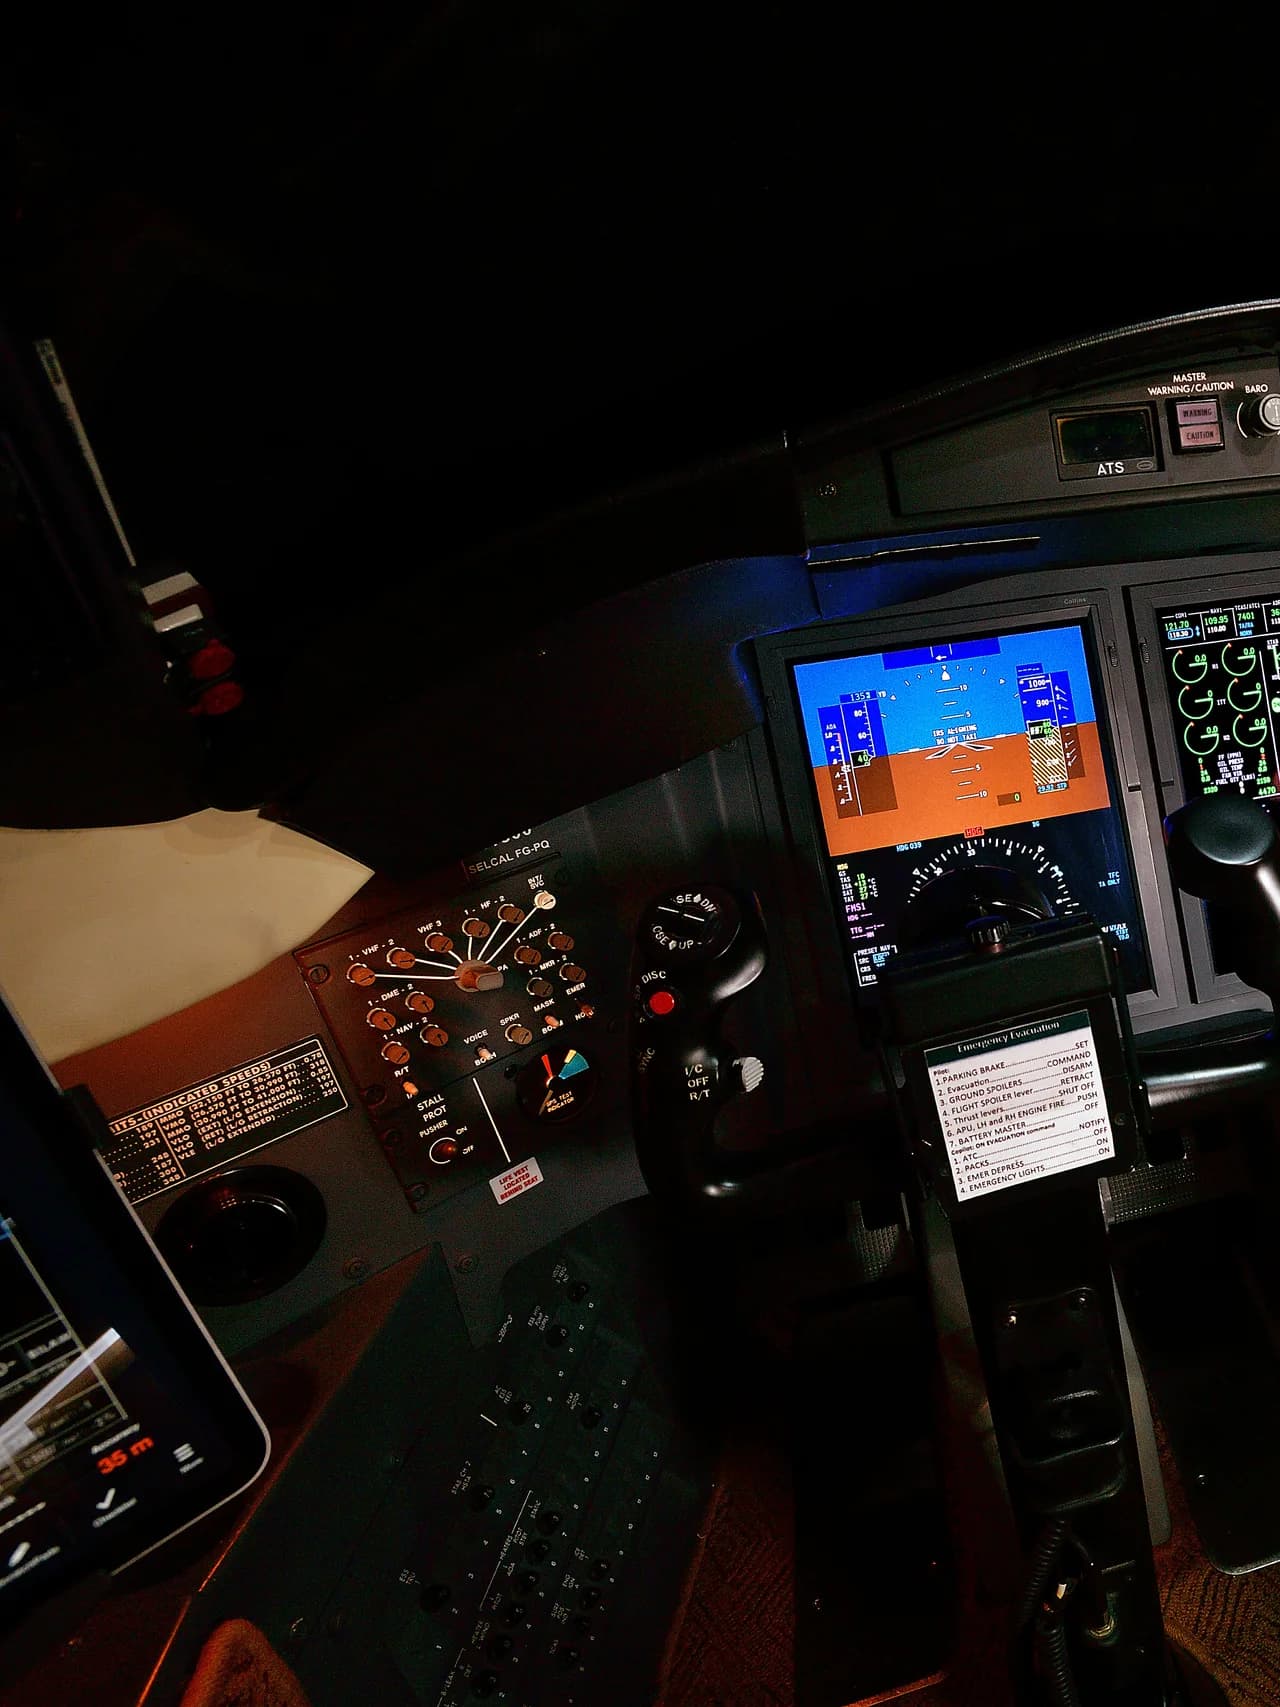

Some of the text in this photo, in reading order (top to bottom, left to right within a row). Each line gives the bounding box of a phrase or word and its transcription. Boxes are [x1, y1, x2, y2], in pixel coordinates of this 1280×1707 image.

[1172, 371, 1207, 383] MASTER
[1147, 381, 1234, 397] WARNING/CAUTION
[1244, 383, 1269, 394] BARO
[1182, 406, 1213, 420] WARNING
[1185, 429, 1215, 442] CAUTION
[1096, 461, 1125, 475] ATS
[1204, 615, 1229, 626] 109.95
[1237, 612, 1255, 621] 7401
[1164, 620, 1190, 632] 121.70
[959, 684, 968, 692] 10
[1258, 786, 1277, 795] 4470
[468, 839, 550, 875] SELCAL FG-PQ
[845, 902, 866, 913] FMS1
[417, 924, 435, 934] VHF
[642, 970, 667, 985] DISC
[381, 990, 400, 1002] DME
[566, 983, 586, 996] EMER
[533, 999, 555, 1012] MASK
[499, 1013, 520, 1026] SPKR
[463, 1029, 489, 1045] VOICE
[957, 1021, 1060, 1054] Emergency Evacuation
[980, 1061, 1005, 1075] BRAKE
[1075, 1040, 1089, 1050] SET
[222, 1061, 271, 1088] SPEEDS)
[394, 1066, 410, 1078] R/T
[685, 1063, 703, 1076] I/C
[947, 1050, 1091, 1095] Evacuation COMMAND
[687, 1076, 709, 1088] OFF
[949, 1061, 1093, 1105] GROUND SPOILERS DISARM
[163, 1059, 326, 1131] VMO 318
[689, 1088, 711, 1101] R/T
[951, 1071, 1094, 1116] FLIGHT SPOILER lever RETRACT
[159, 1083, 250, 1124] MMO TO
[417, 1094, 445, 1112] STALL
[954, 1081, 1095, 1126] Thrust levers SHUT OFF
[976, 1091, 1098, 1129] LH and RH ENGINE FIRE PUSH
[422, 1105, 447, 1122] PROT
[178, 1087, 338, 1160] VLE 250
[419, 1119, 449, 1139] PUSHER
[958, 1101, 1099, 1146] BATTERY MASTER OFF
[170, 1134, 190, 1145] VLO
[962, 1118, 1106, 1162] ATC NOTIFY
[986, 1122, 1056, 1146] EVACUATION command
[964, 1126, 1108, 1172] PACKS OFF
[499, 1165, 529, 1186] LIFE VEST
[967, 1160, 1025, 1182] EMER DEPRESS
[969, 1164, 1046, 1192] EMERGENCY LIGHTS
[500, 1175, 538, 1200] BEHIND SEAT
[503, 1173, 530, 1191] LOCATED
[96, 1450, 129, 1477] 35
[130, 1436, 155, 1456] m
